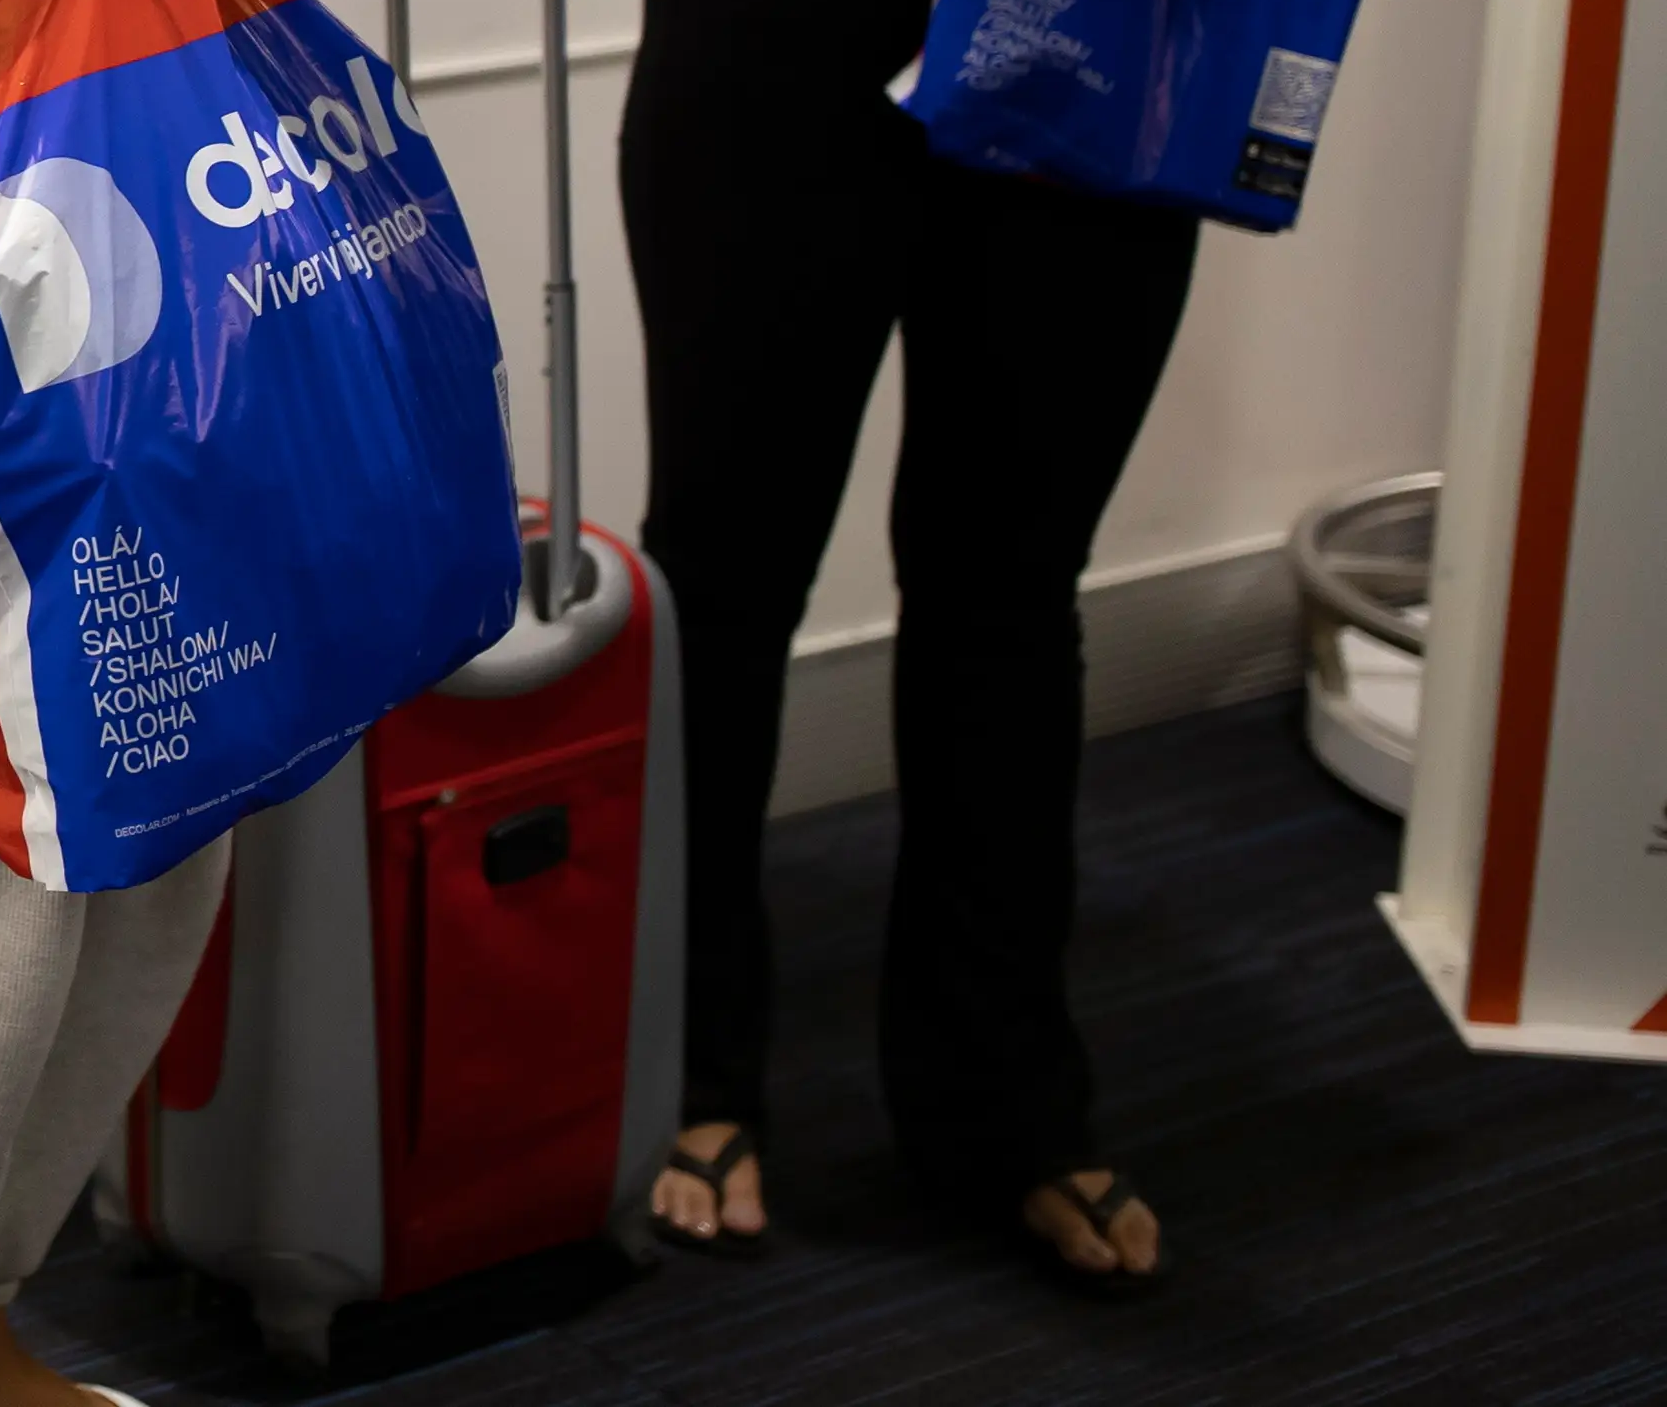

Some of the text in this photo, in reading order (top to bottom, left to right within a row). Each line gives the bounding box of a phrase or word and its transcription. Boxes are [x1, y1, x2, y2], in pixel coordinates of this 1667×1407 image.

[226, 253, 326, 317] Viver
[71, 525, 143, 564] OLÁ/
[73, 552, 165, 595] HELLO
[78, 575, 180, 626] /HOLA/
[81, 611, 175, 657] SALUT
[89, 620, 229, 687] /SHALOM/
[92, 632, 277, 718] KONNICHI WA/
[99, 701, 197, 748] ALOHA
[105, 734, 190, 779] /CIAO
[114, 812, 180, 839] DECOLAR.COM
